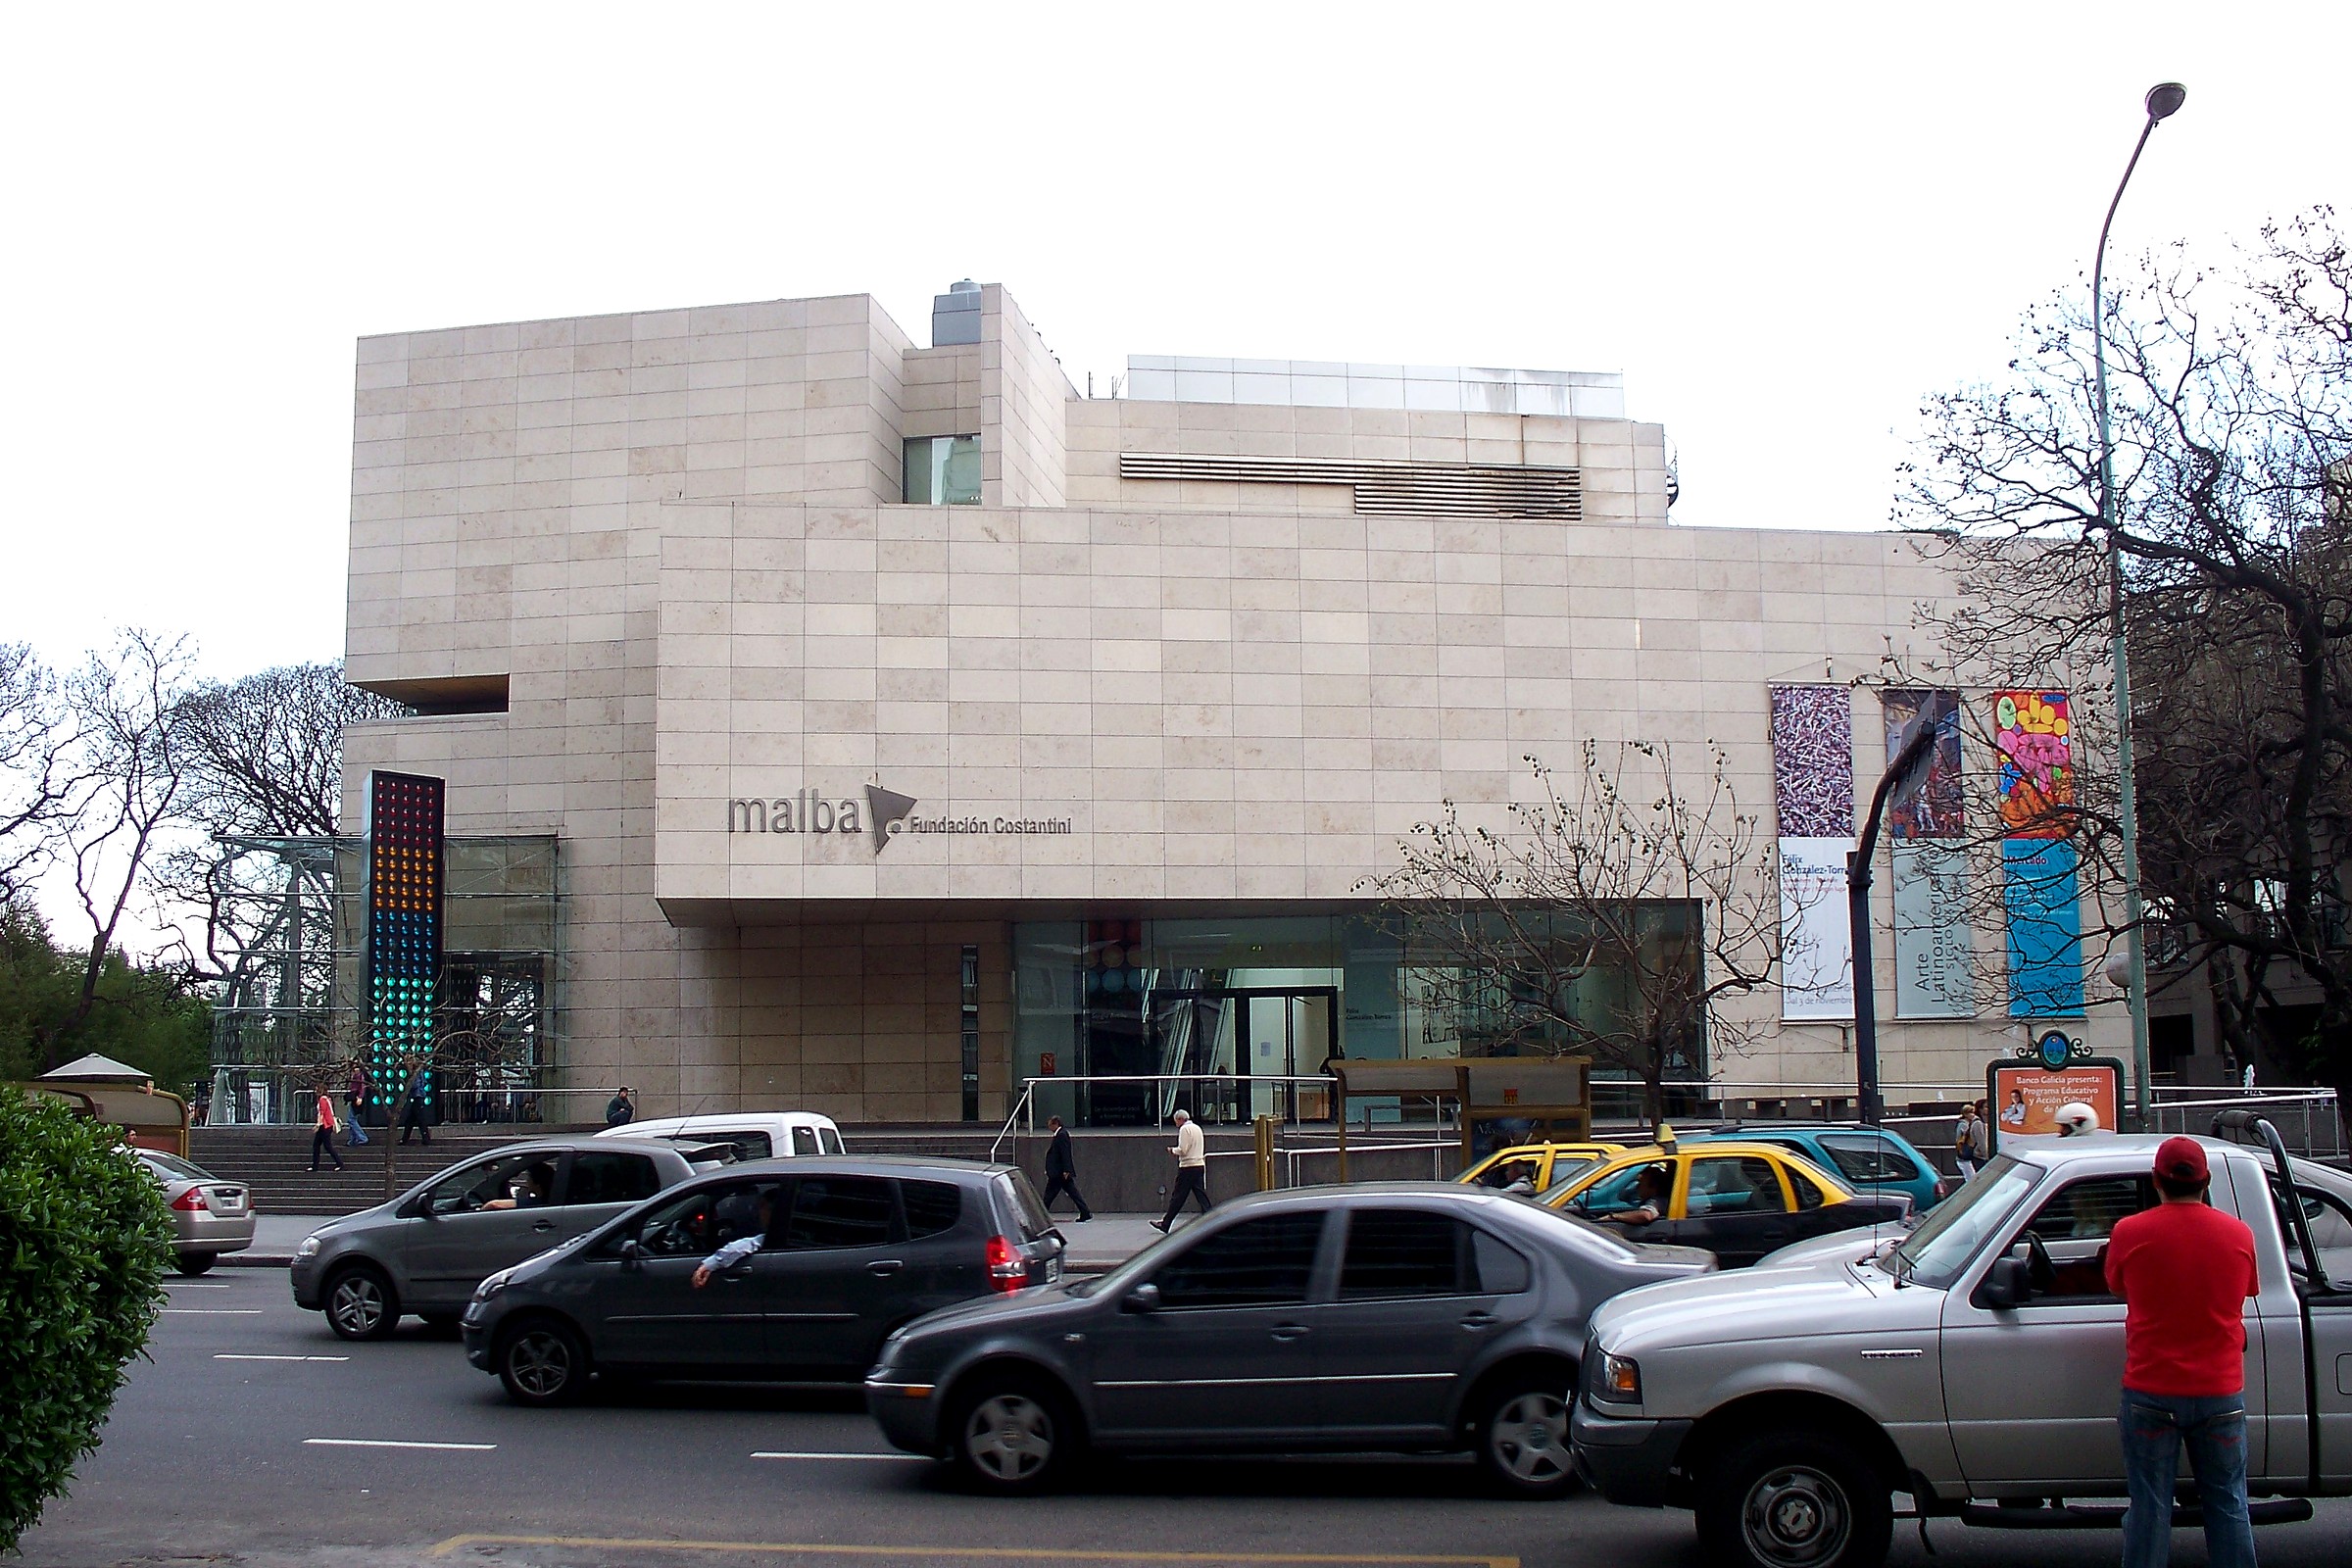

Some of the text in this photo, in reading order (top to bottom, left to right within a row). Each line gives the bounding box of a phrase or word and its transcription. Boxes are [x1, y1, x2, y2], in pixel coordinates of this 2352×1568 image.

[727, 788, 863, 834] malba
[909, 814, 1072, 835] Fundación Costantini
[1914, 953, 1930, 992] Arte
[2040, 1075, 2066, 1084] Galicia
[2067, 1076, 2103, 1085] presenta:
[2023, 1086, 2099, 1097] Programa Educativo
[2029, 1098, 2034, 1106] y
[2063, 1095, 2093, 1103] Cultural
